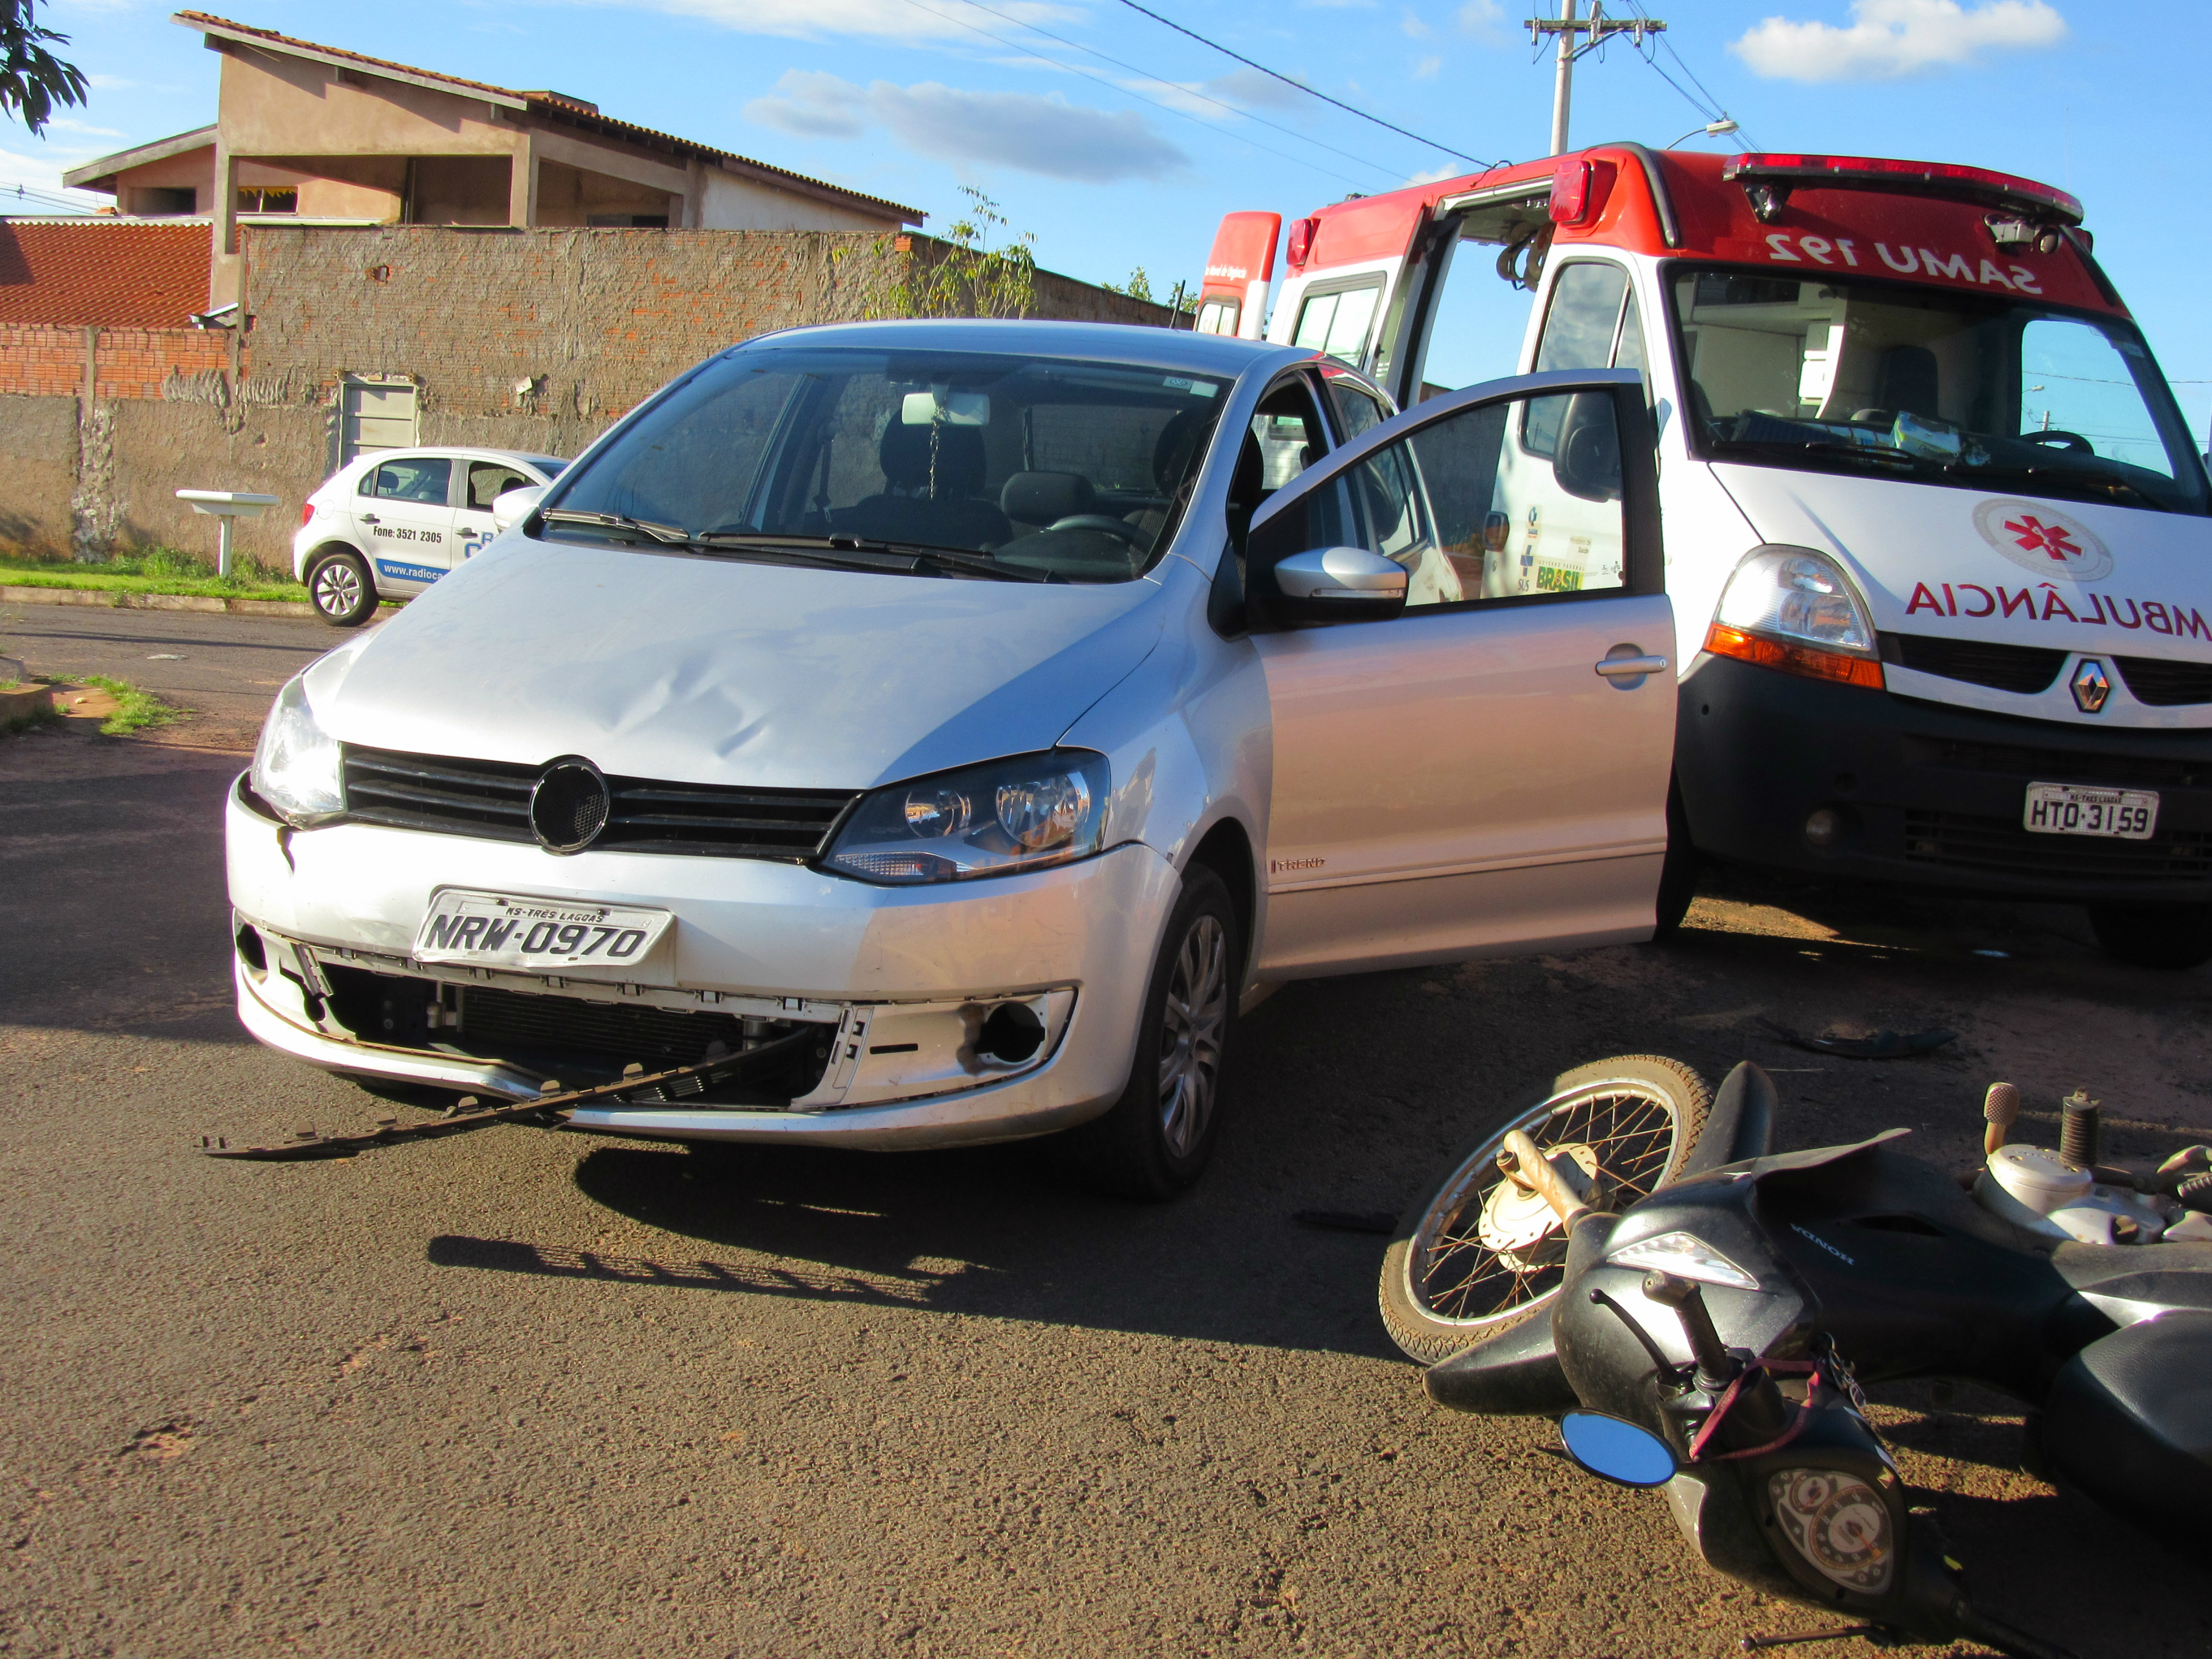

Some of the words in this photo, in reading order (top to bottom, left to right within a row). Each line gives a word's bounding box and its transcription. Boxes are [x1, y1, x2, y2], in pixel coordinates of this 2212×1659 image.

[373, 525, 395, 538] Fone:
[396, 528, 416, 541] 3521
[420, 531, 442, 543] 2305
[1518, 578, 1529, 592] SUS
[1536, 566, 1582, 592] BRASIL
[1278, 858, 1325, 871] TREND
[559, 912, 605, 923] LAGOAS
[1789, 1222, 1854, 1265] HONDA
